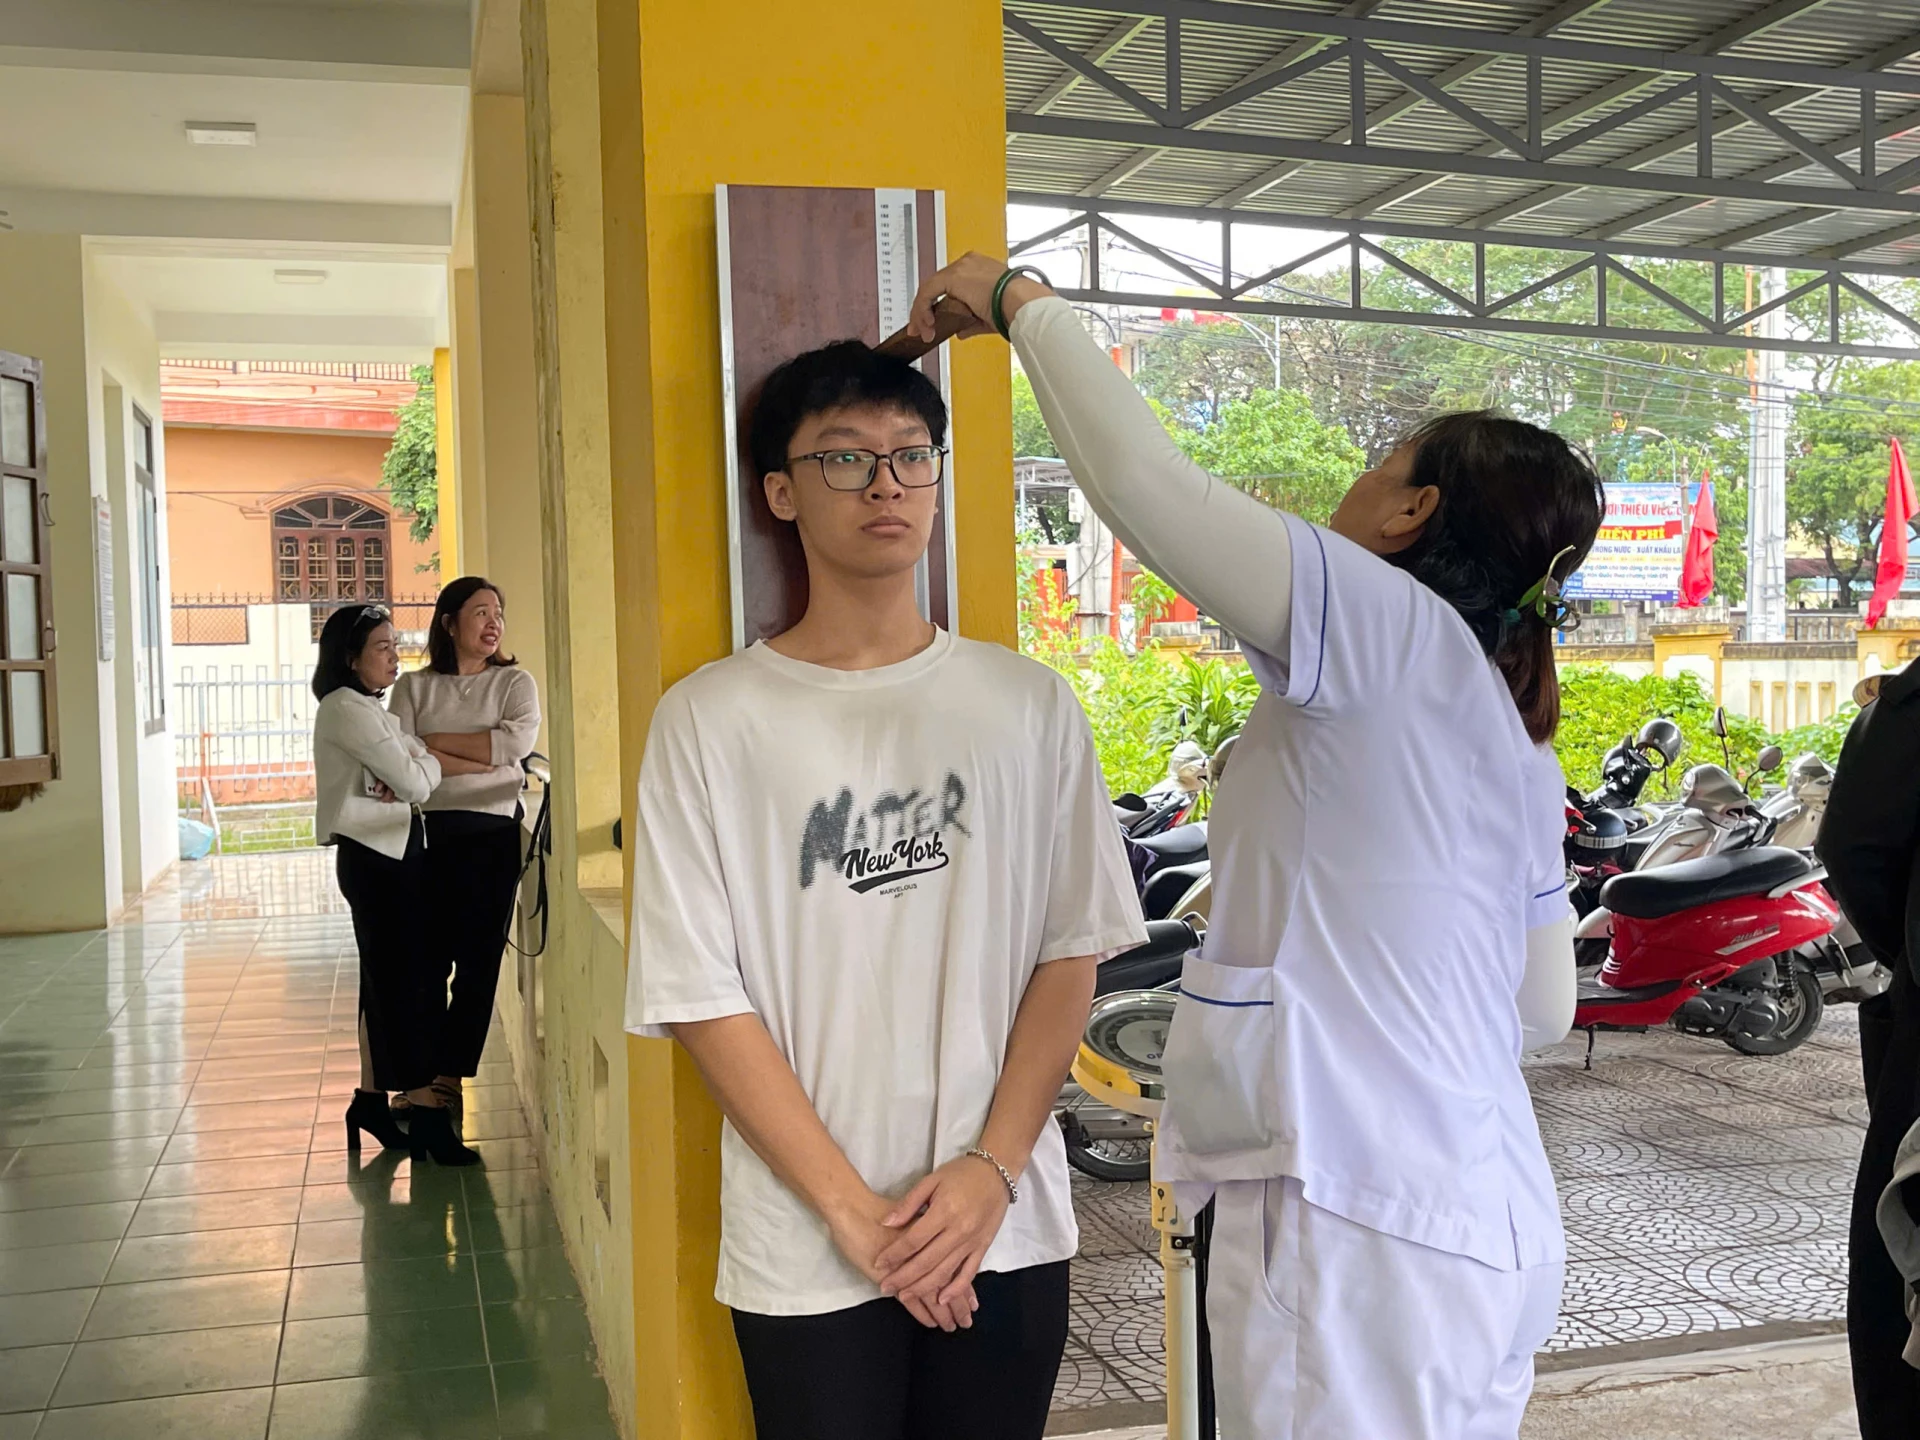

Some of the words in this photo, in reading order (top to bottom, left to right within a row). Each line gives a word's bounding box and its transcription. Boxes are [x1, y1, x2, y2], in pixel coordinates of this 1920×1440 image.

[840, 847, 898, 879] New
[892, 831, 947, 869] York
[880, 883, 917, 895] MARVELOUS
